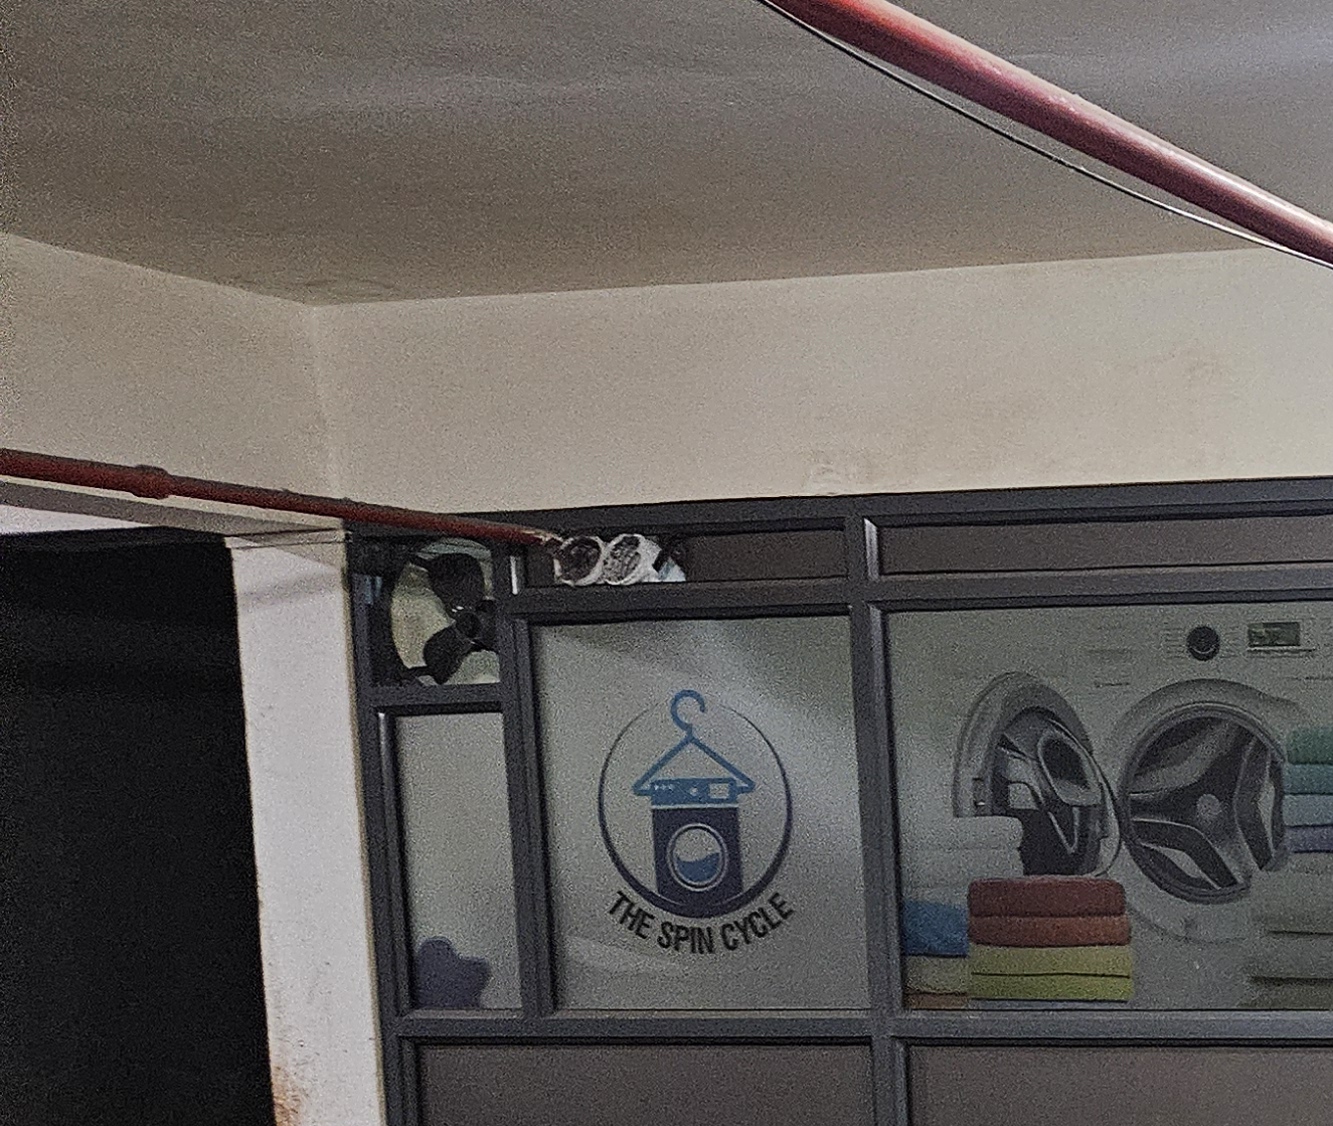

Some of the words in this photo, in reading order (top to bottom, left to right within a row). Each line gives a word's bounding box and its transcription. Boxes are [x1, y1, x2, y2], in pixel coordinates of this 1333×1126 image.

[607, 889, 652, 940] THE
[655, 919, 715, 956] SPIN
[720, 890, 796, 952] CYCLE
